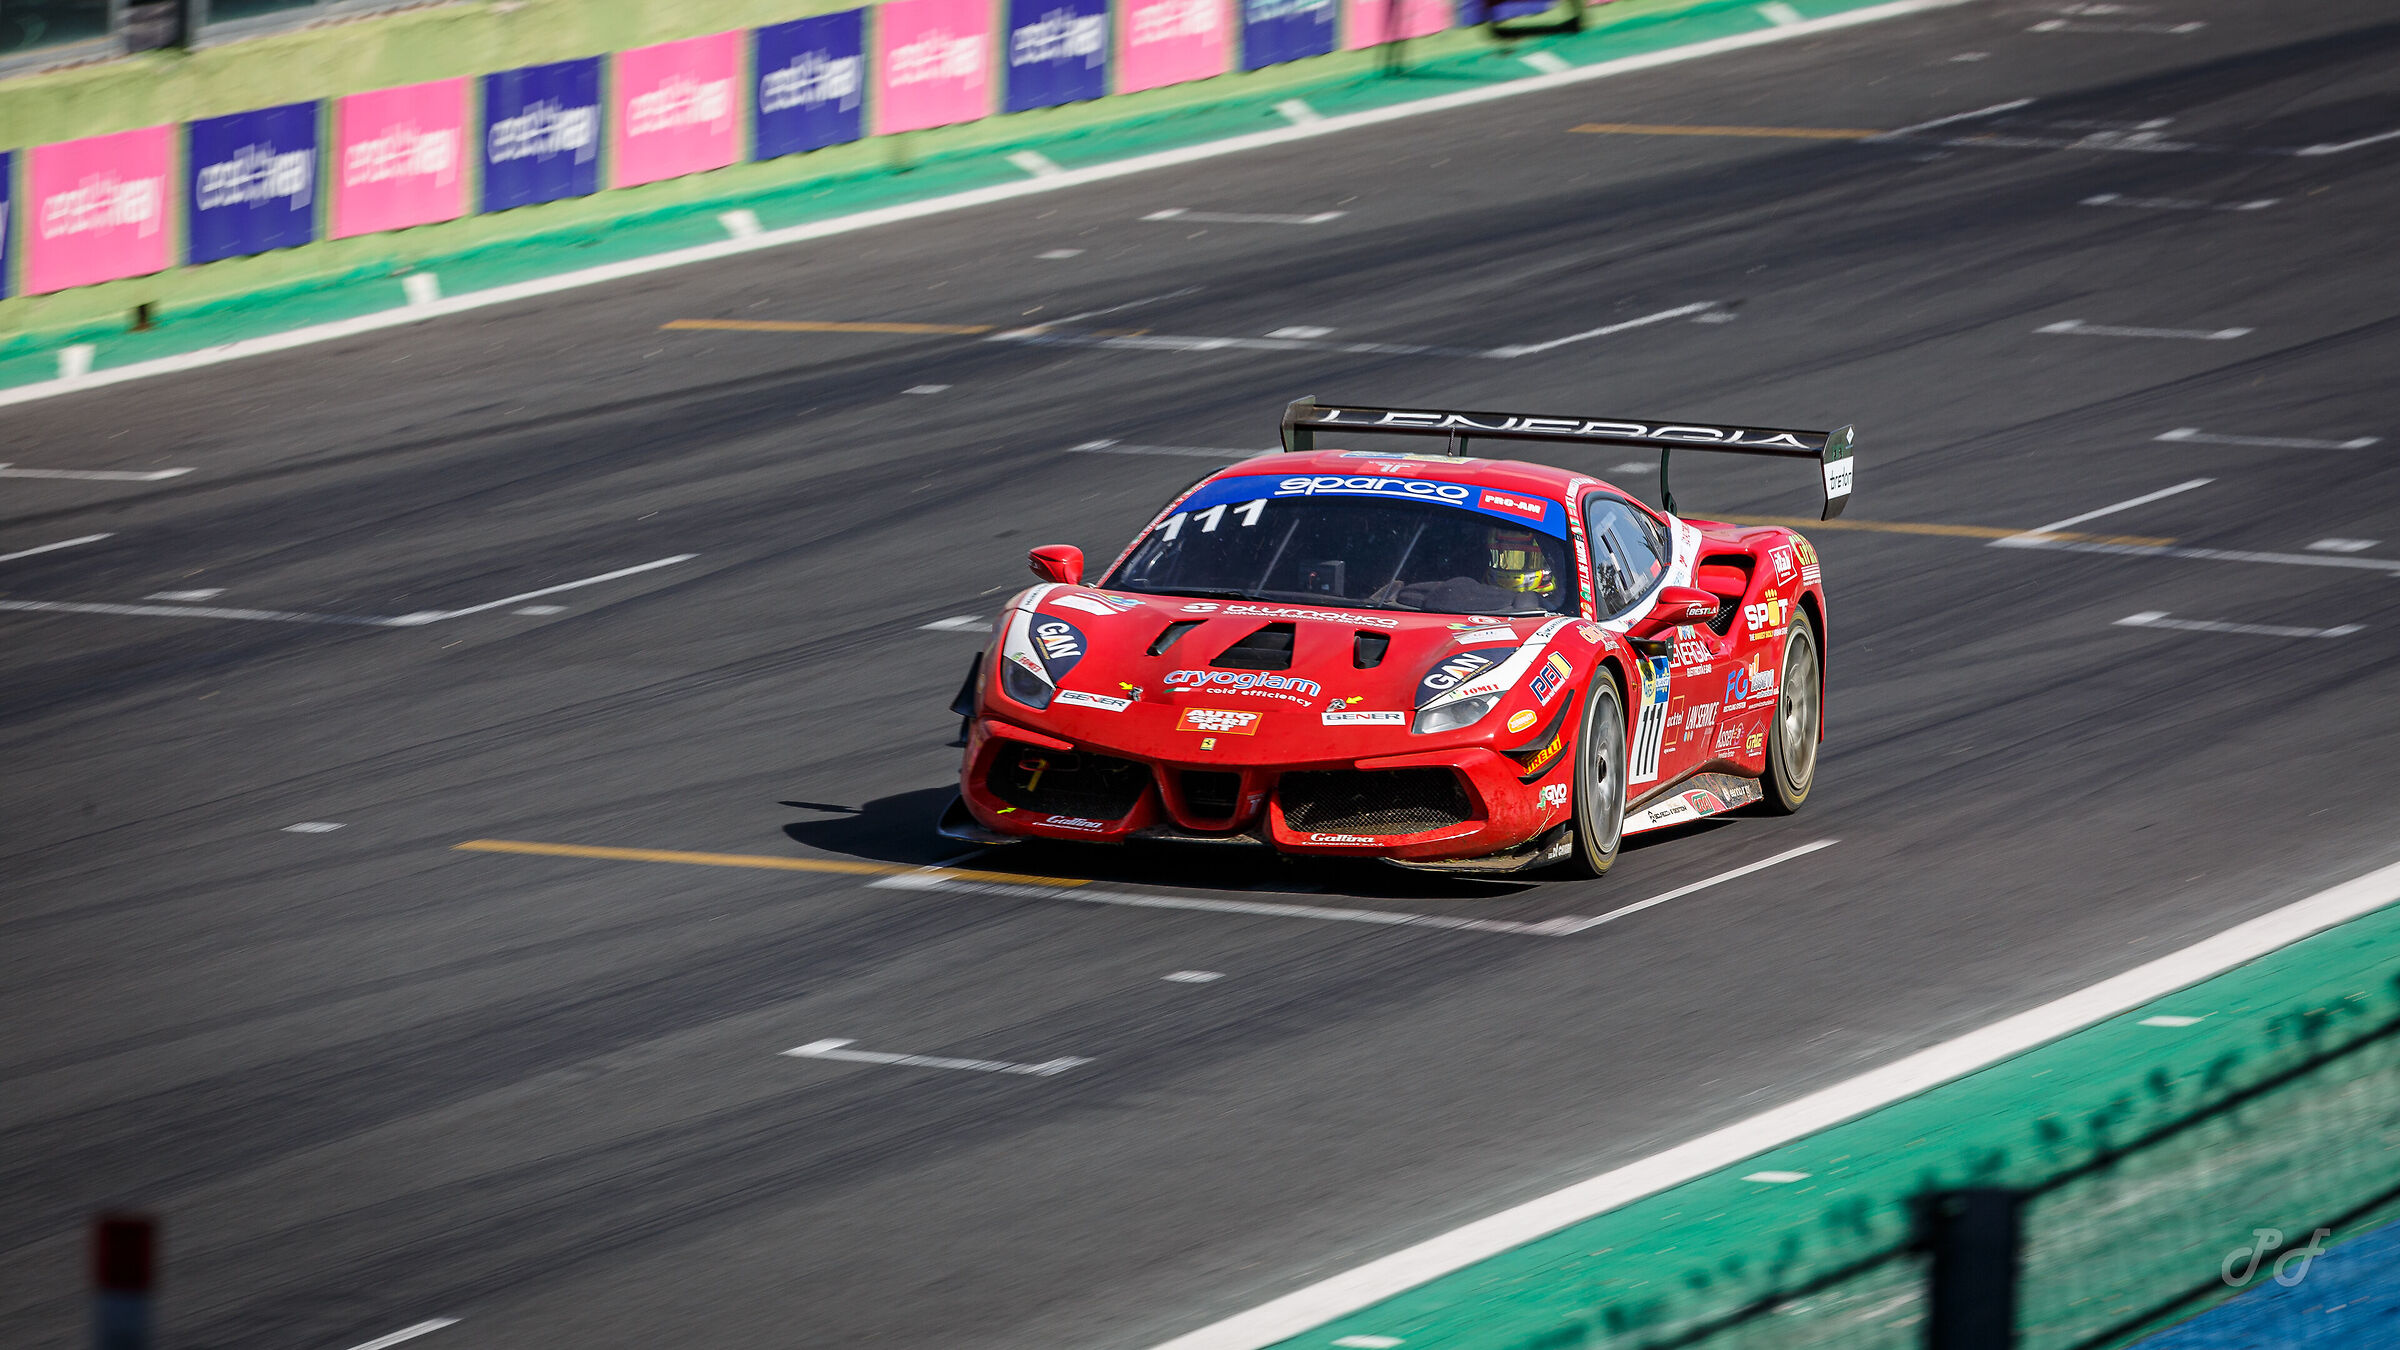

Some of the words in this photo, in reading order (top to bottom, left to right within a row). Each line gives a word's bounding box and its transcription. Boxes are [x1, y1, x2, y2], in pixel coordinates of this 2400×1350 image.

[1279, 476, 1470, 500] sparco
[1484, 494, 1541, 514] PRO-AM
[1154, 497, 1268, 542] 111
[1226, 604, 1400, 626] blumatica
[1743, 598, 1789, 631] SPOT
[1036, 622, 1082, 659] GAN
[1423, 652, 1490, 690] GAN
[1163, 669, 1321, 698] cryogiam
[1725, 667, 1748, 704] FG
[1062, 691, 1127, 707] GENER
[1206, 687, 1236, 696] cold
[1241, 689, 1313, 708] efficiency
[1186, 709, 1259, 721] AUTO
[1187, 716, 1250, 727] SPRI
[1197, 723, 1236, 731] NT
[1635, 702, 1664, 777] 111
[1046, 815, 1104, 828] Gallina
[1310, 833, 1375, 843] Gallina
